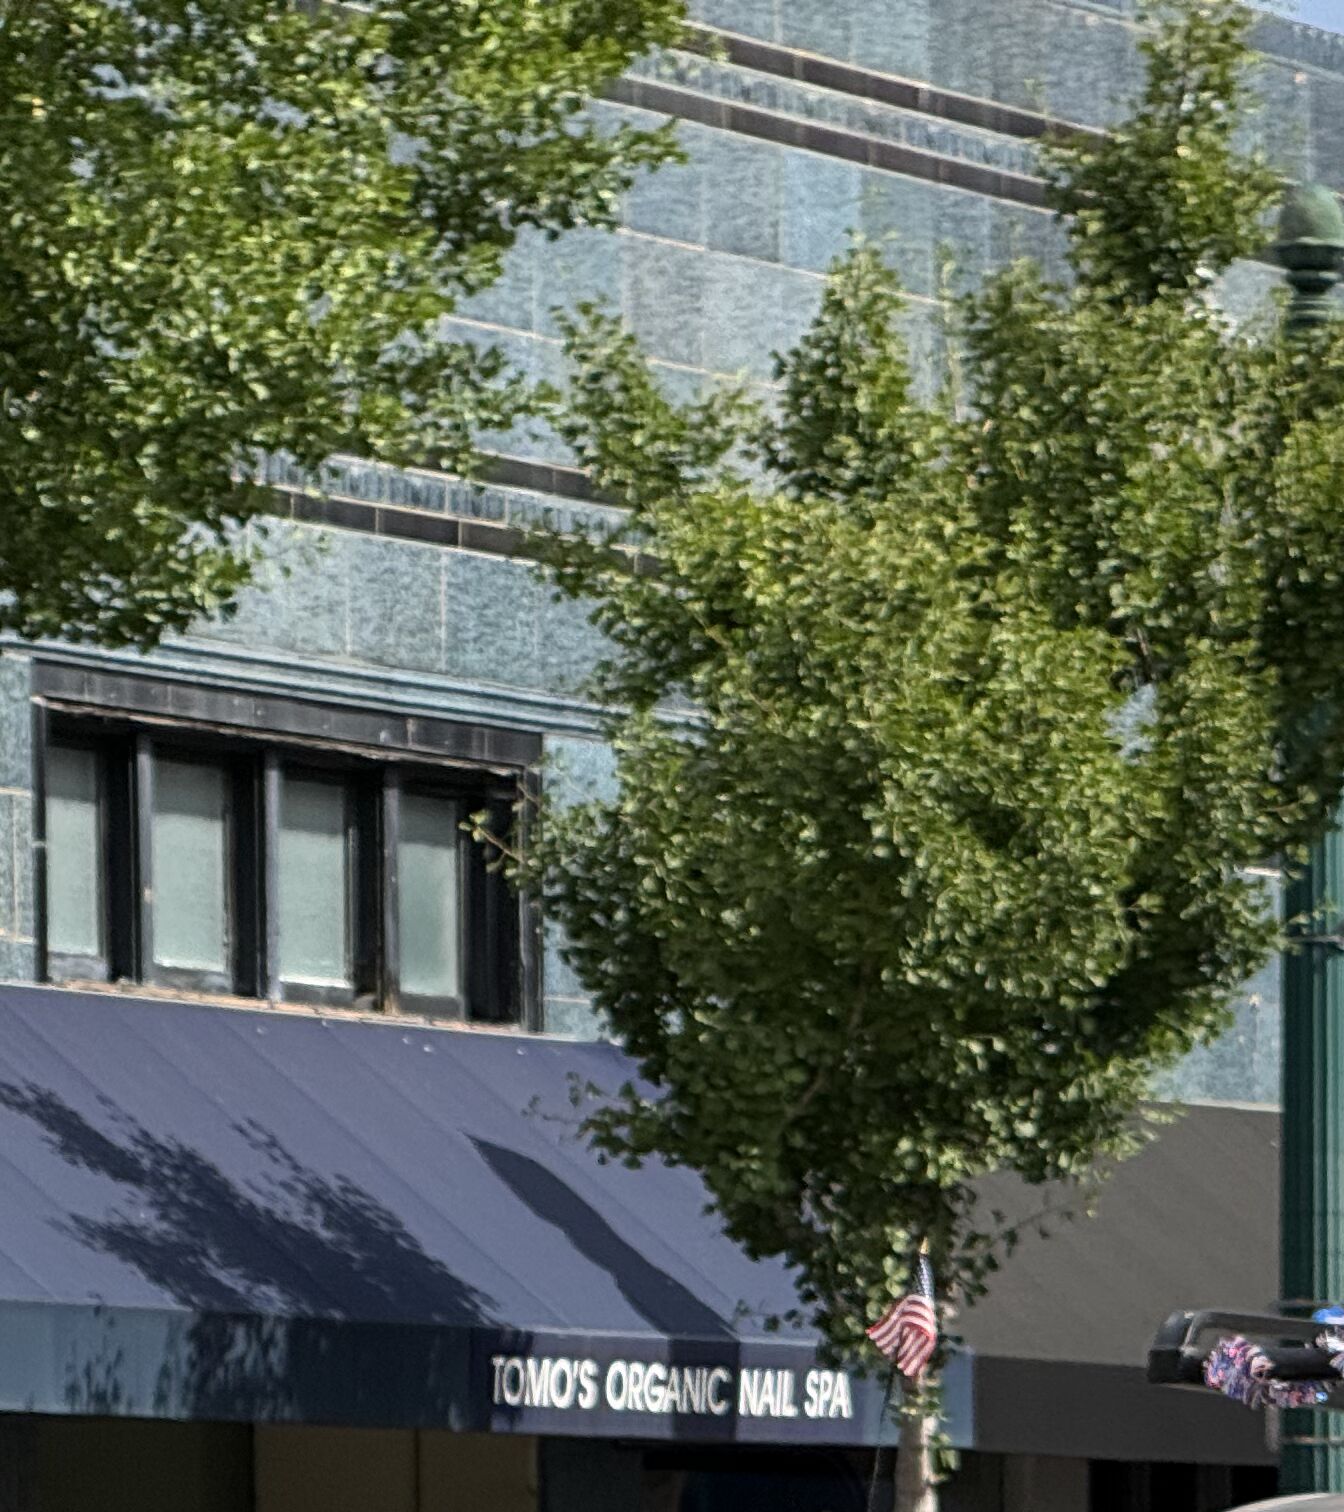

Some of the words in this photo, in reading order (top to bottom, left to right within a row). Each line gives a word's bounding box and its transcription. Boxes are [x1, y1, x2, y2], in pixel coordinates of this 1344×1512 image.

[491, 1356, 600, 1409] TOMO'S
[605, 1360, 733, 1416] ORGANIC
[738, 1367, 799, 1417] NAIL
[804, 1369, 853, 1419] SPA
